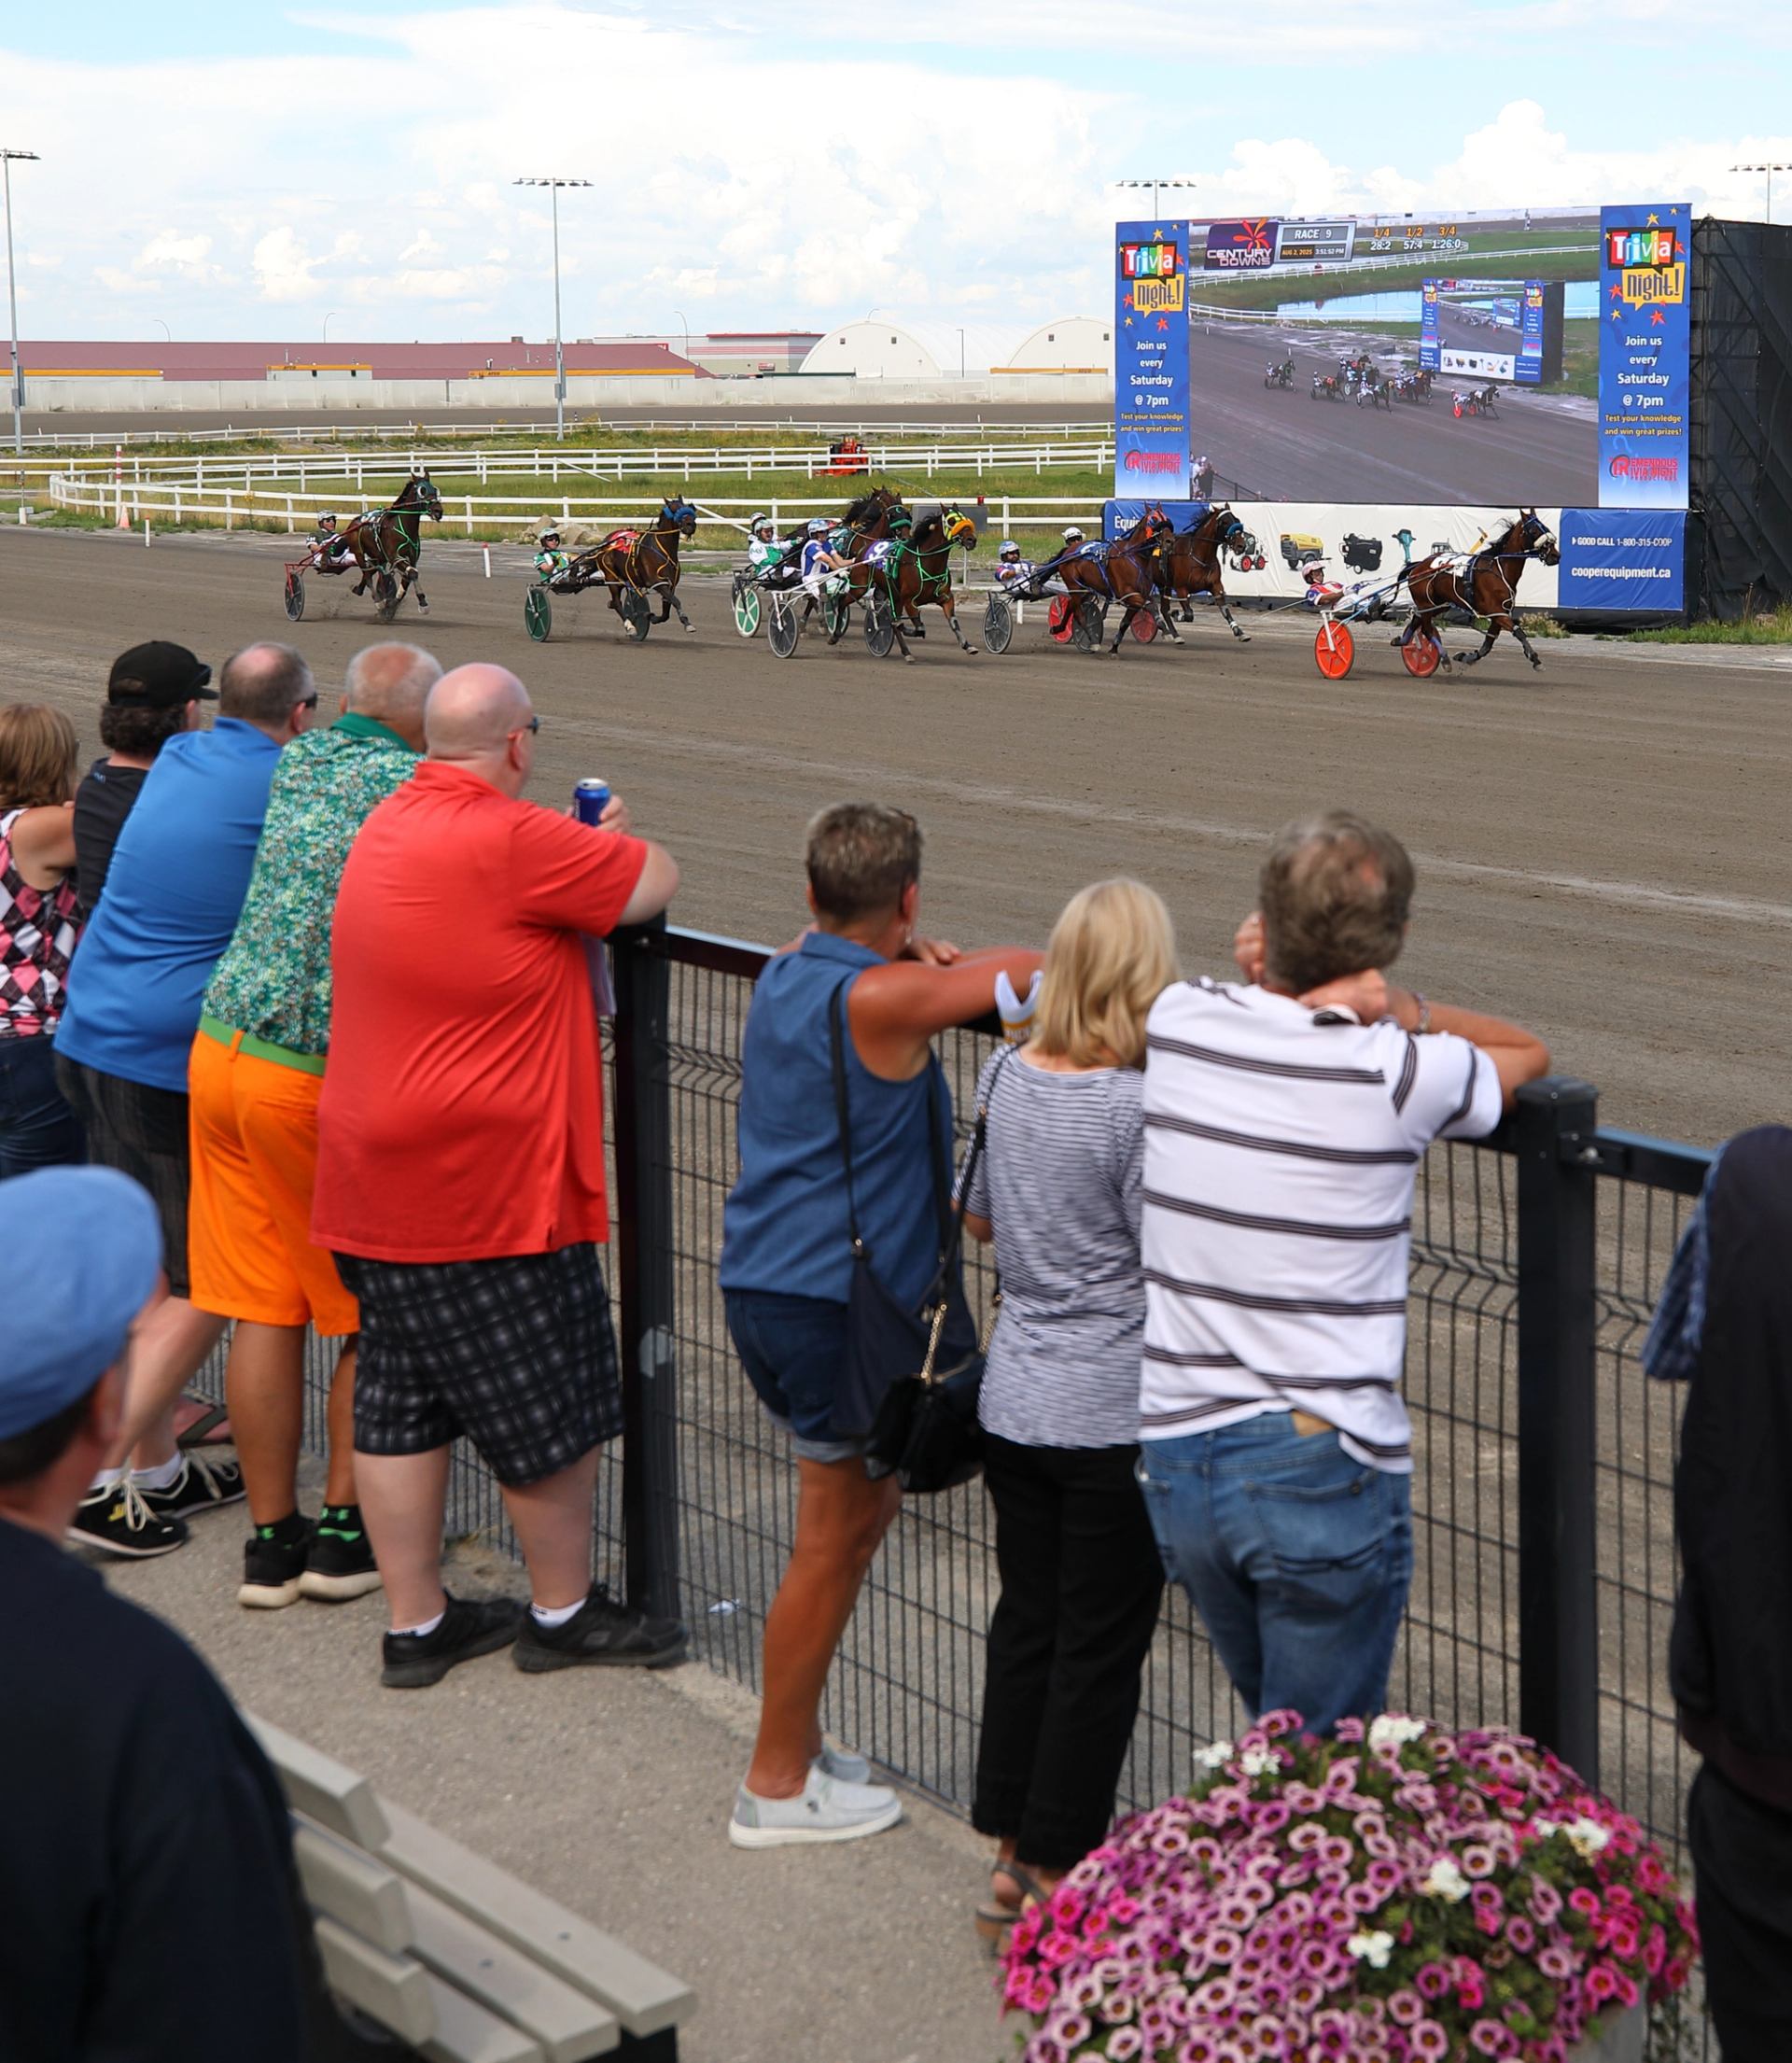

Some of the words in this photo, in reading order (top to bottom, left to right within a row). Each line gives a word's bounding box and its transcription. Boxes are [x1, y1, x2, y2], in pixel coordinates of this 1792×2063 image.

[1295, 230, 1320, 239] RACE
[1325, 230, 1333, 239] 9
[1375, 228, 1390, 238] 1/4
[1407, 227, 1423, 237] 1/2
[1439, 226, 1456, 236] 3/4
[1370, 242, 1391, 250] 28:2
[1403, 241, 1423, 250] 57:4
[1432, 239, 1461, 249] 1:26:0
[1613, 234, 1673, 263] Trivia
[1207, 247, 1273, 259] CENTURY
[1126, 246, 1173, 275] Trivia
[1219, 257, 1271, 267] DOWNS
[1136, 341, 1155, 351] Join
[1155, 342, 1167, 351] us
[1625, 335, 1647, 346] Join
[1650, 337, 1662, 346] us
[1140, 359, 1164, 369] every
[1630, 356, 1658, 367] every
[1130, 375, 1173, 388] Saturday
[1617, 372, 1670, 386] Saturday
[1135, 395, 1143, 406] @
[1146, 395, 1169, 408] 7pm
[1622, 395, 1633, 406] @
[1636, 395, 1664, 409] 7pm
[1149, 414, 1183, 422] knowledge
[1641, 414, 1682, 424] knowledge
[1163, 426, 1184, 434] prizes!
[1635, 428, 1656, 437] great
[1657, 428, 1682, 437] prizes!
[1577, 537, 1596, 546] GOOD
[1597, 537, 1615, 546] CALL
[1617, 538, 1673, 547] 1-800-315-COOP
[1571, 566, 1672, 580] cooperequipment.ca
